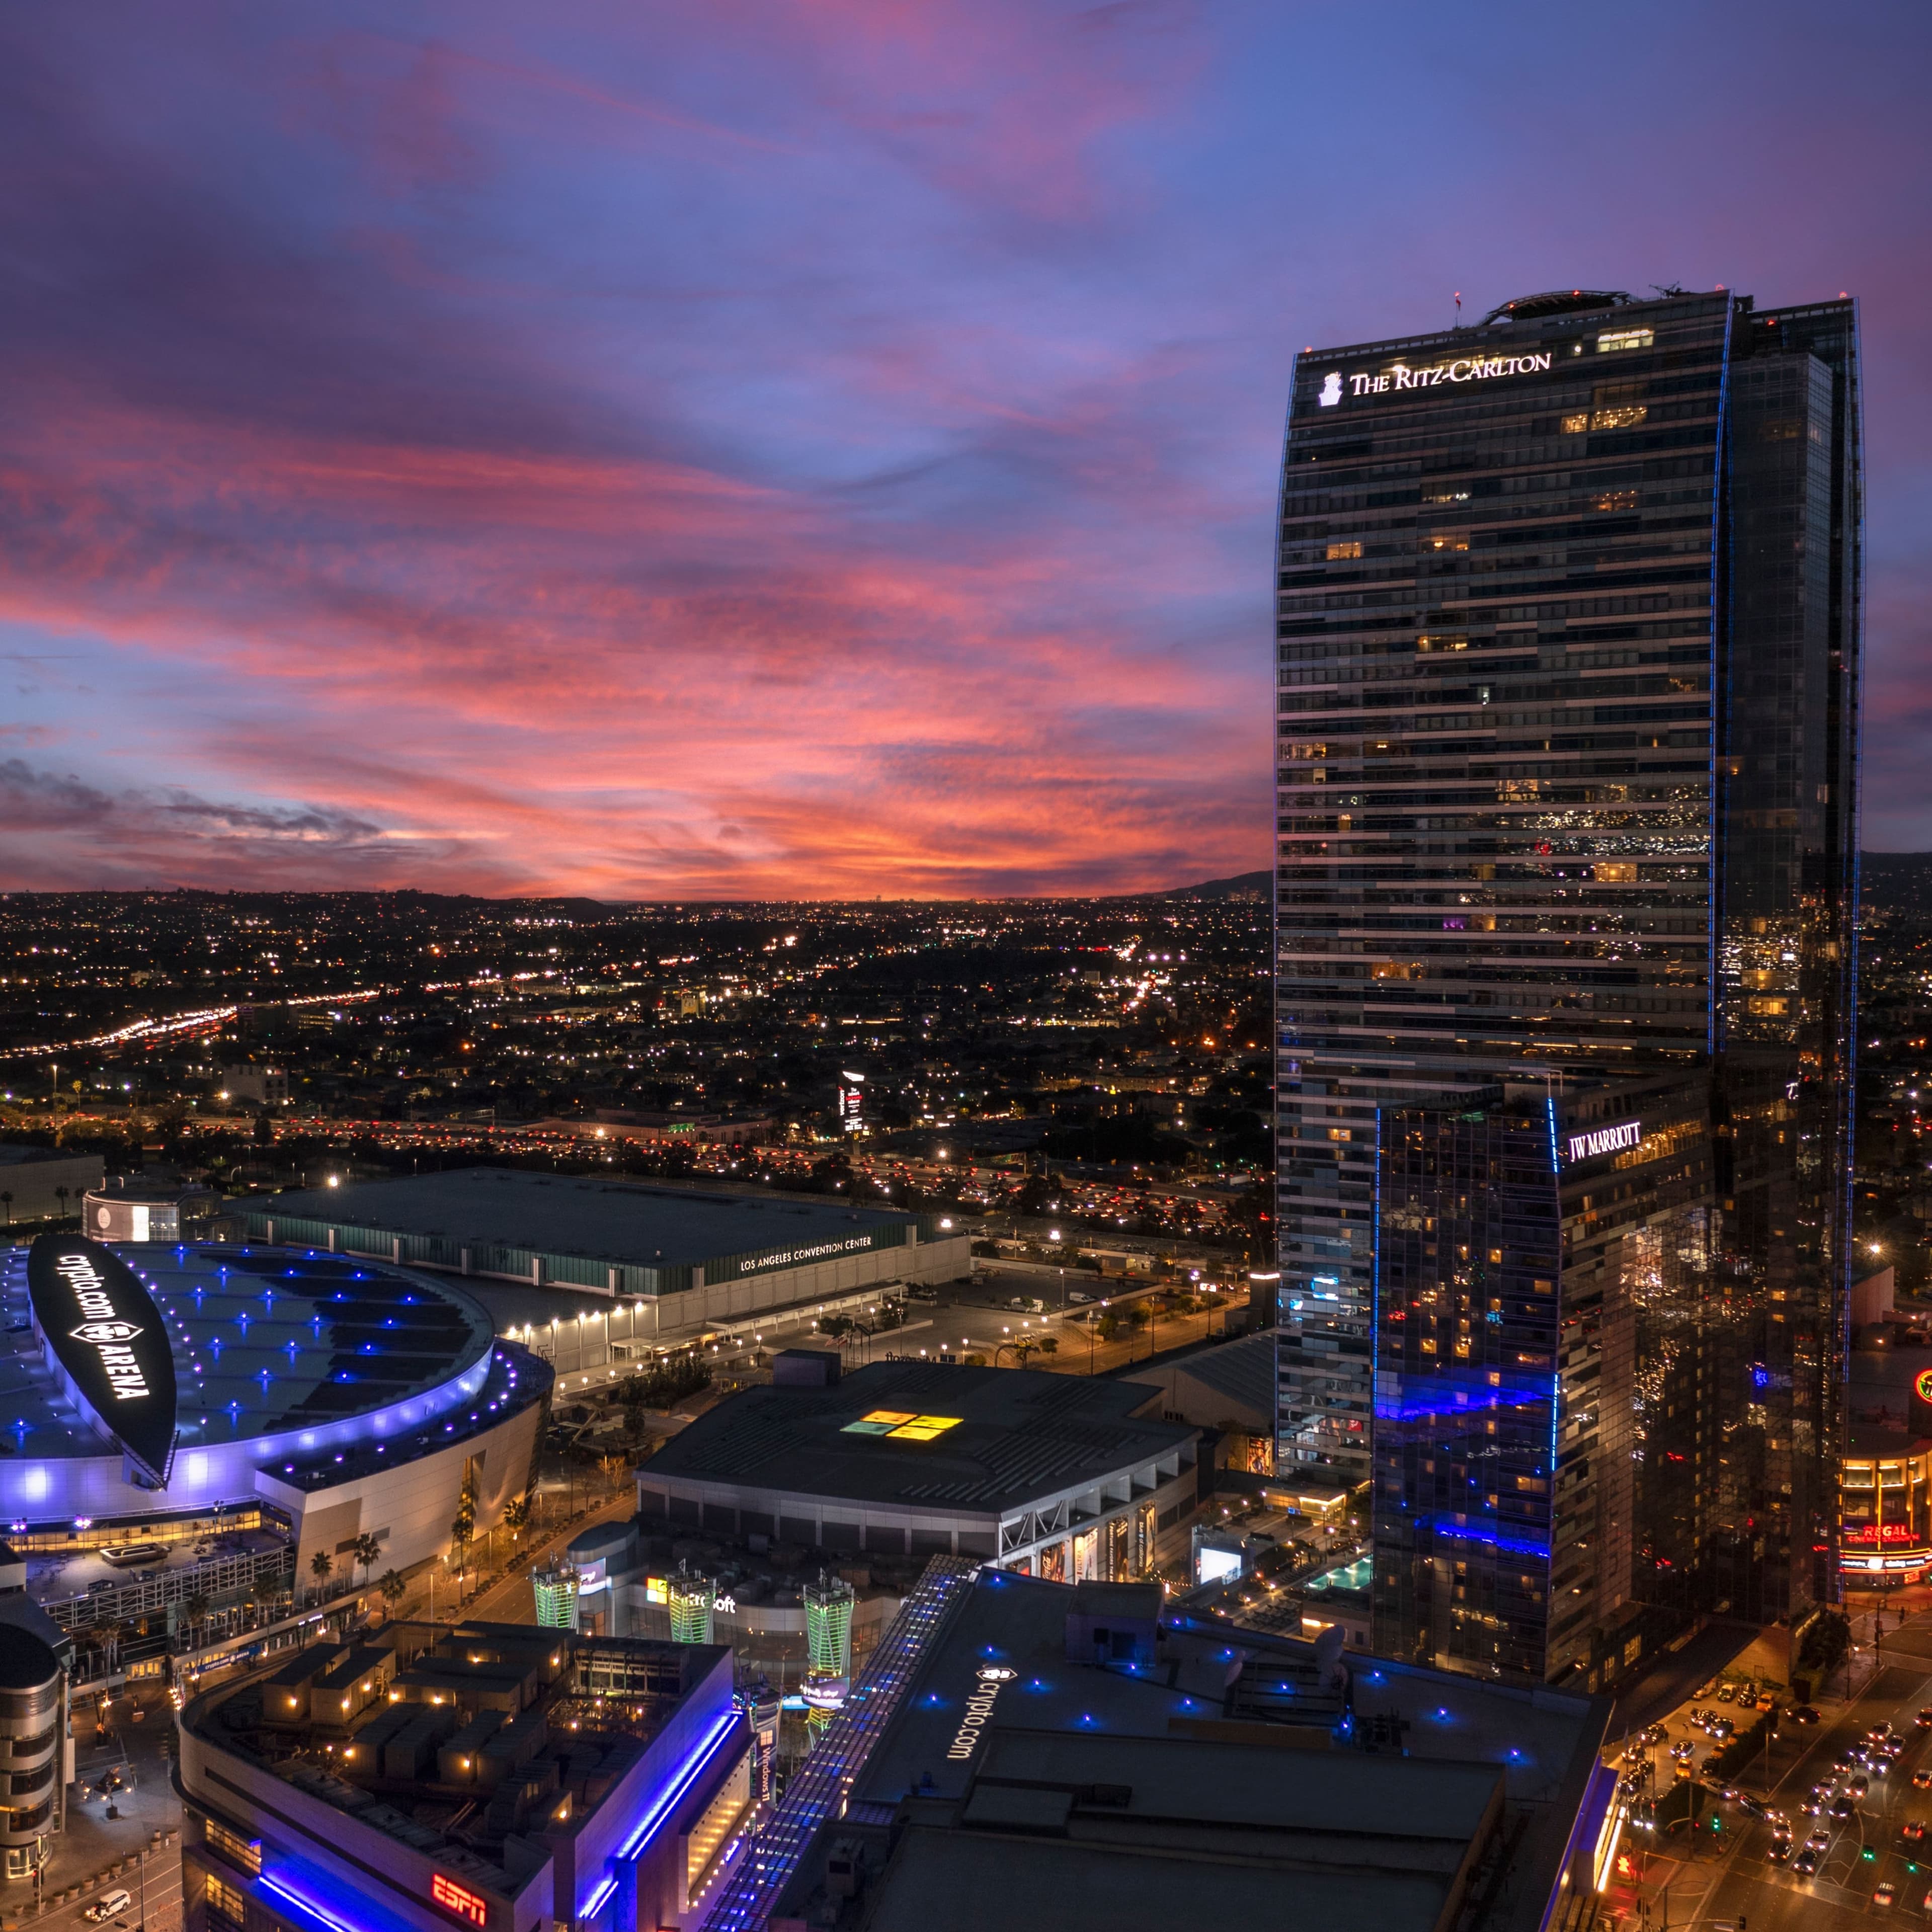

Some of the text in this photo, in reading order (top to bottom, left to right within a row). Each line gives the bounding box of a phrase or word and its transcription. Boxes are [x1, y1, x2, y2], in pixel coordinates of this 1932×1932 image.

[1350, 353, 1551, 395] THE RITZ-CARLTON
[1569, 1121, 1640, 1162] JW MARRIOTT
[741, 1237, 871, 1271] LOS ANGELES CONVENTION CENTER
[56, 1255, 116, 1319] crypto.com
[98, 1346, 150, 1399] ARENA
[1864, 1525, 1907, 1536] REGAL
[205, 1651, 250, 1670] crypto.com ARENA
[947, 1683, 1000, 1758] crypto.com
[762, 1747, 771, 1802] Windows 11
[434, 1874, 486, 1926] ESPN
